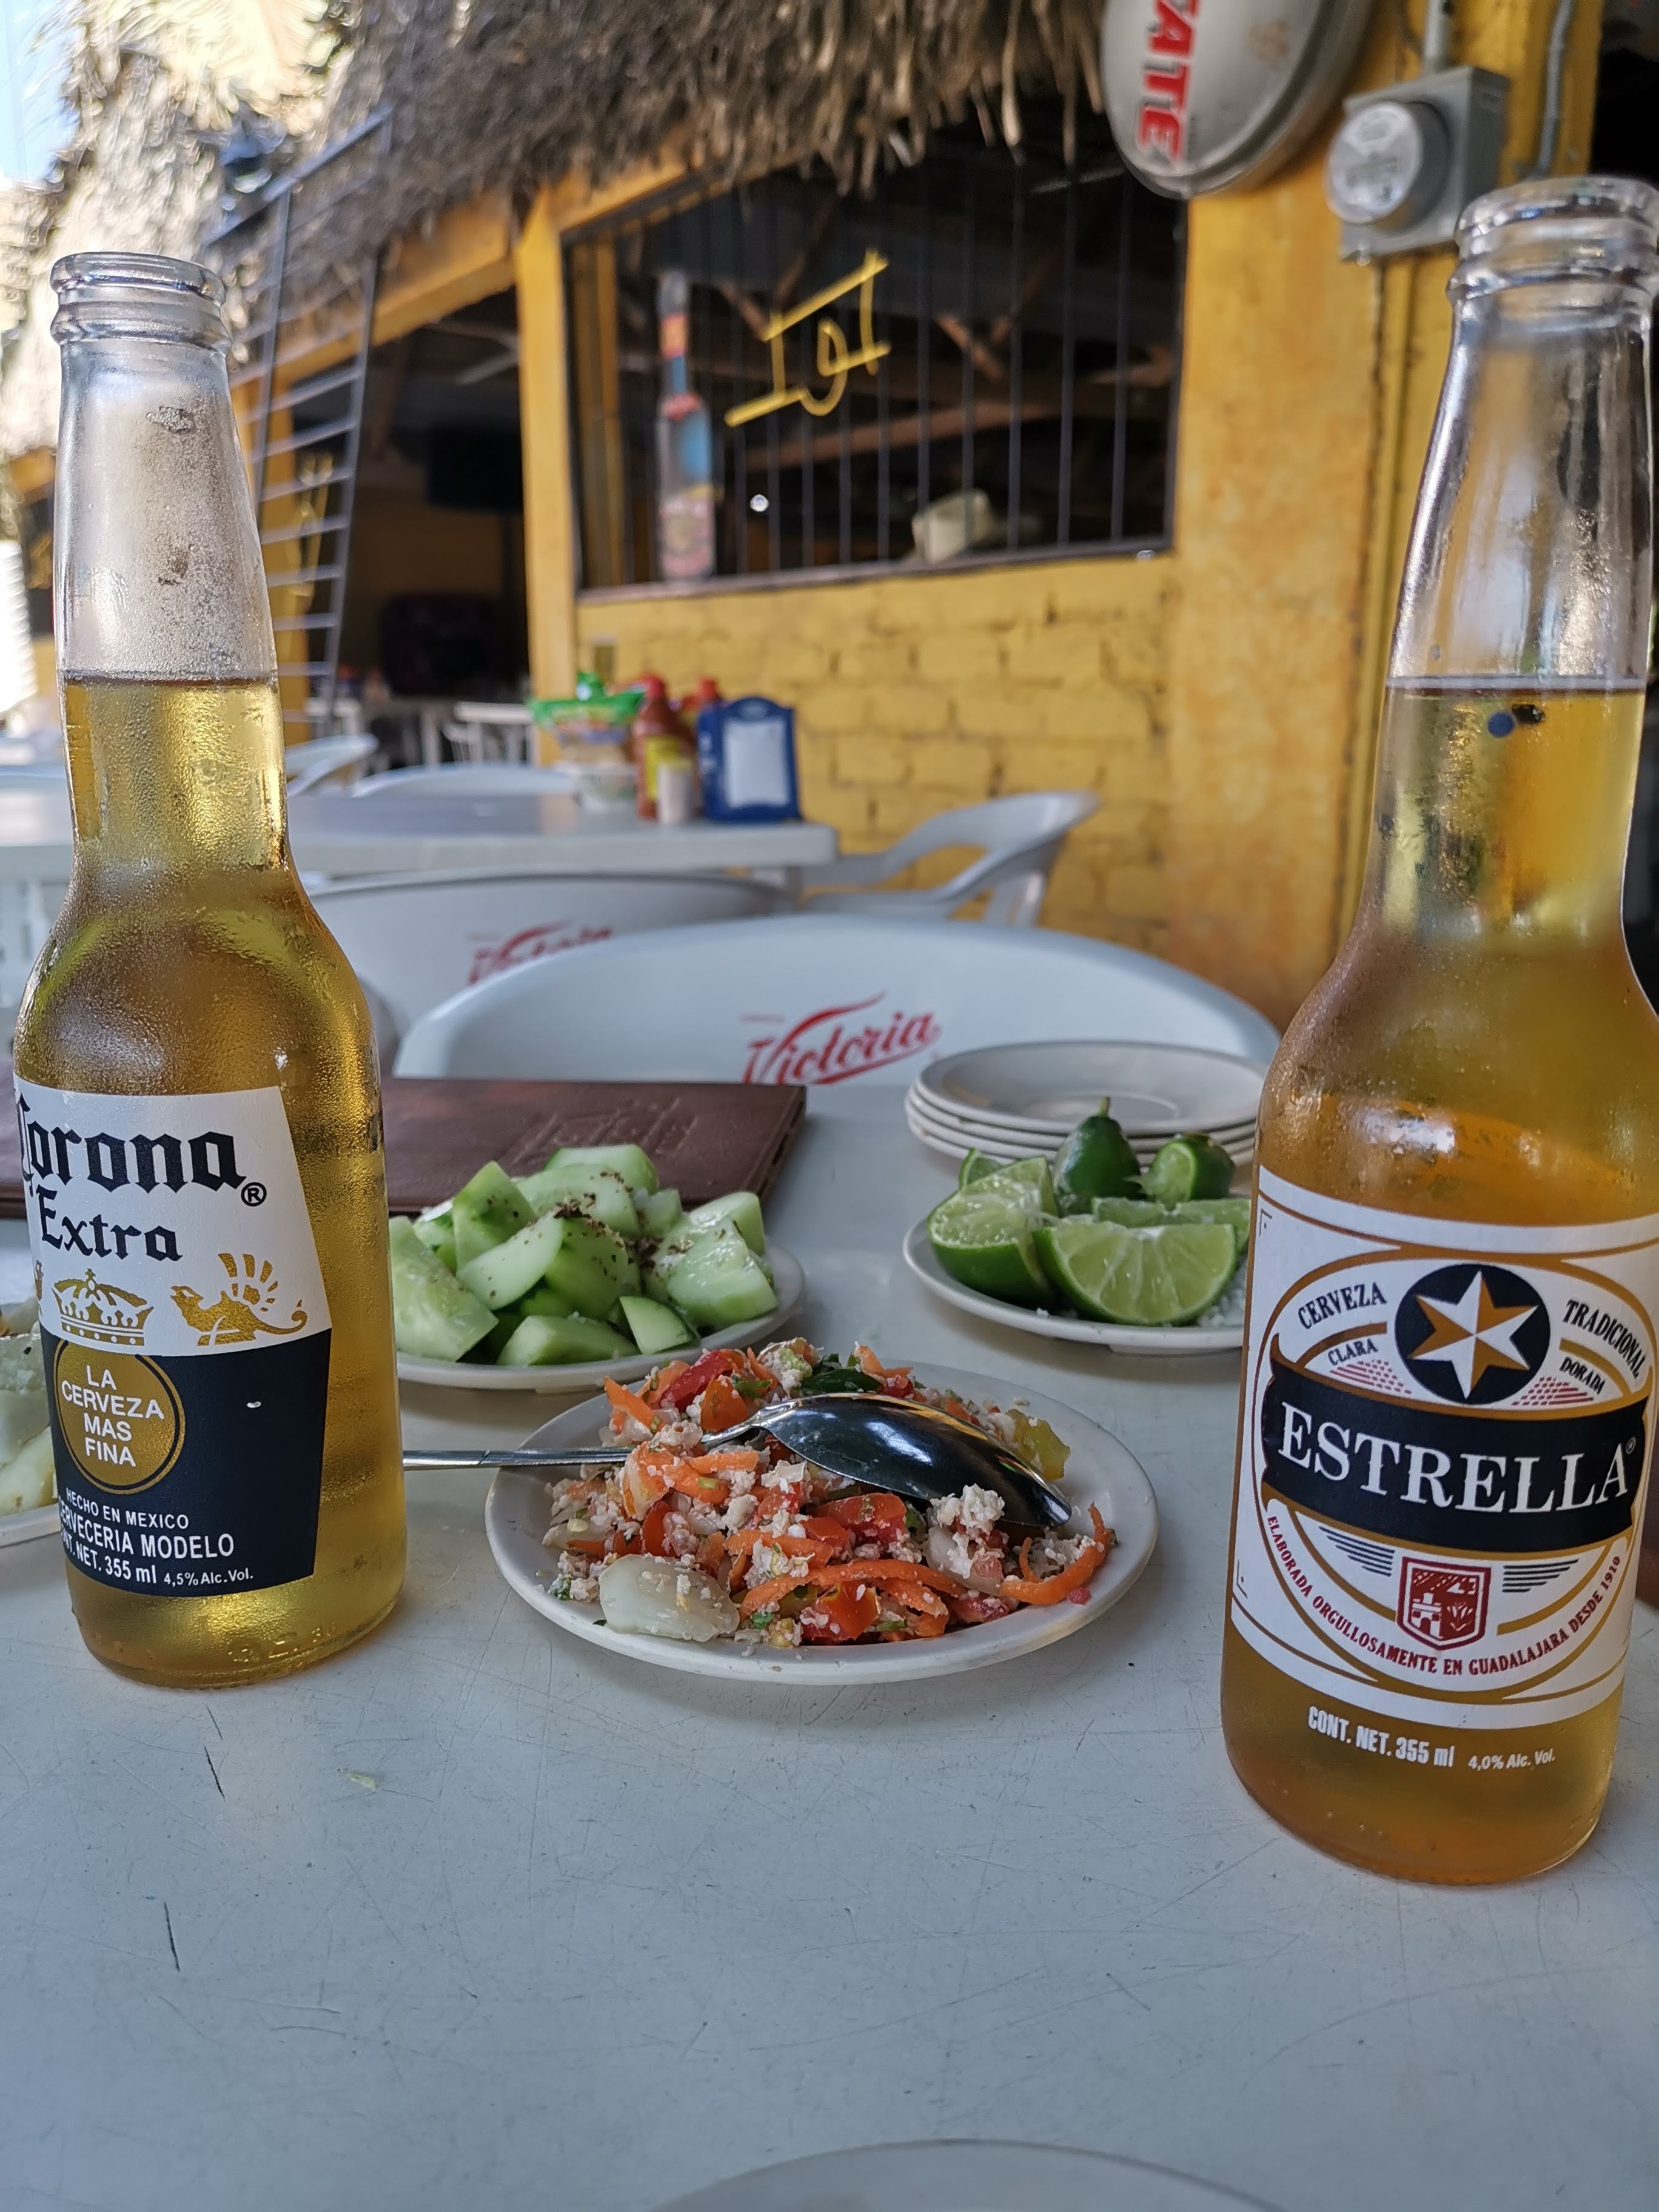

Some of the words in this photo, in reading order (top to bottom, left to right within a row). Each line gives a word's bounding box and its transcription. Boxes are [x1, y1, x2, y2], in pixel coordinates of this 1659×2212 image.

[1139, 0, 1197, 161] ATE
[35, 1184, 183, 1262] Extra
[1298, 1281, 1388, 1330] CERVEZA
[1562, 1298, 1646, 1380] TRADICIONAL
[86, 1365, 117, 1390] LA
[1327, 1338, 1379, 1366] CLARA
[1559, 1356, 1606, 1395] DORADA
[61, 1380, 165, 1419] CERVEZA
[84, 1412, 132, 1441] MAS
[85, 1436, 136, 1467] FINA
[66, 1487, 99, 1517] HECHO
[102, 1505, 121, 1523] EN
[125, 1510, 189, 1529] MEXICO
[76, 1541, 101, 1571] NET.
[104, 1555, 132, 1580] 355
[135, 1564, 157, 1584] ml
[164, 1572, 199, 1587] 4,5%
[140, 1533, 234, 1559] MODELO
[1267, 1515, 1313, 1598] ELABORADA
[1312, 1595, 1438, 1674] ORGULLOSAMENTE
[1443, 1658, 1463, 1675] EN
[1468, 1627, 1570, 1676] GUADALAJARA
[1567, 1590, 1604, 1634] DESDE
[1600, 1556, 1621, 1592] 1910
[1307, 1706, 1352, 1744] CONT.
[1355, 1725, 1392, 1757] NET.
[1395, 1737, 1430, 1765] 355
[1433, 1746, 1455, 1768] ml
[1467, 1754, 1504, 1771] 4,0%
[1506, 1754, 1532, 1769] Alc.
[1534, 1748, 1556, 1765] Vol.
